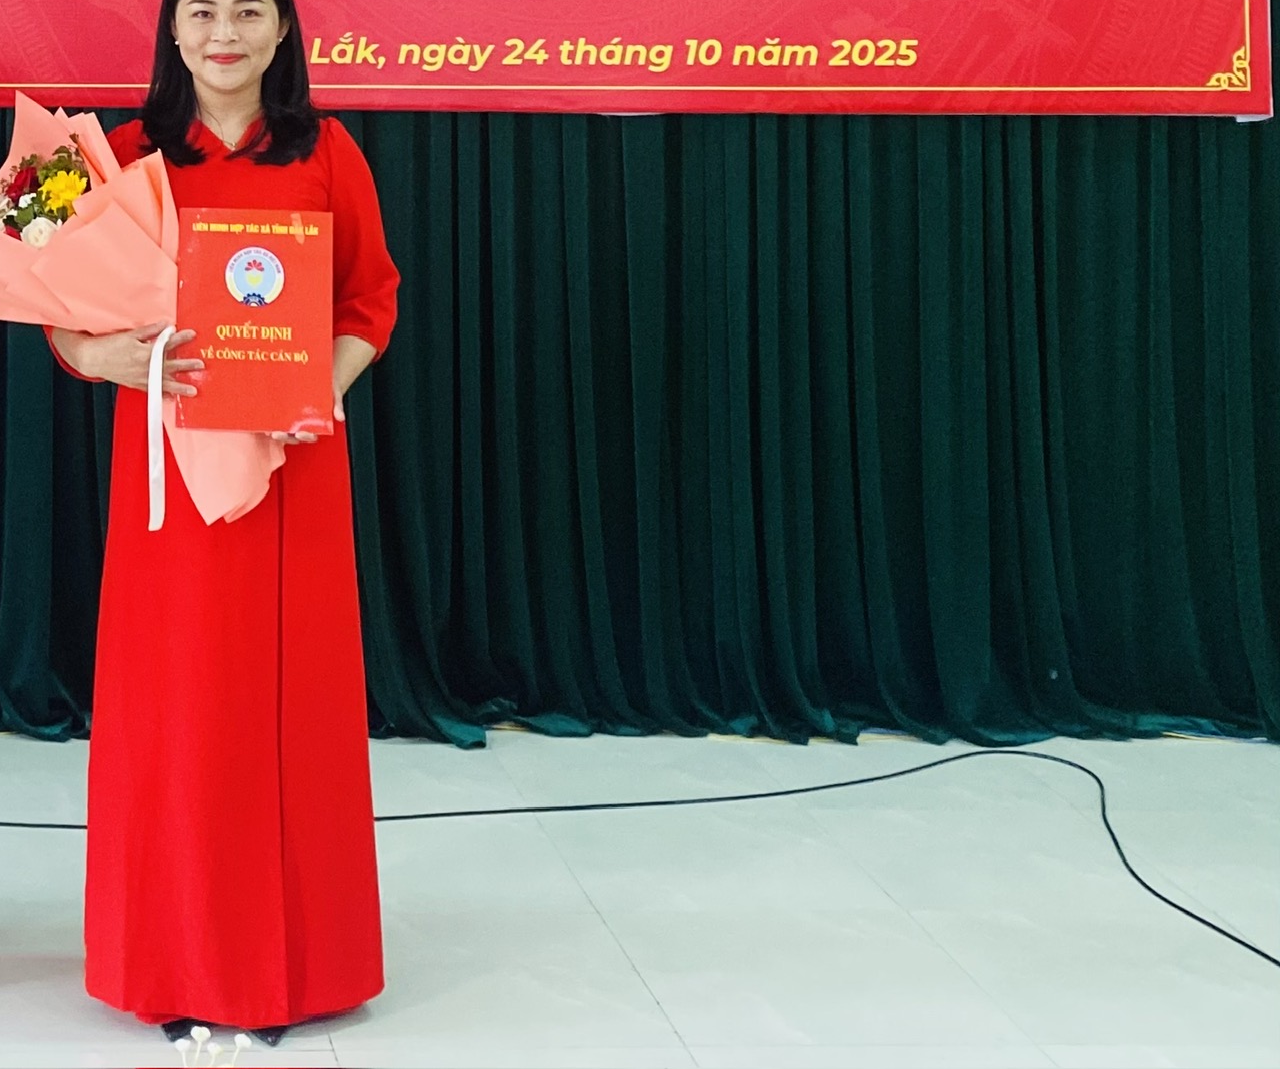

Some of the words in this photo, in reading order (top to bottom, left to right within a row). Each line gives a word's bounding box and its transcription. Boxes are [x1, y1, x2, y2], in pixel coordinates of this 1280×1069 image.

[309, 31, 387, 70] Lắk,
[397, 36, 496, 72] ngày
[501, 38, 550, 66] 24
[559, 37, 674, 73] tháng
[684, 39, 723, 66] 10
[732, 38, 819, 67] năm
[829, 39, 919, 67] 2025
[216, 320, 260, 341] QUYẾT
[261, 326, 292, 343] ĐỊNH
[216, 347, 246, 360] CÔNG
[247, 348, 270, 361] TÁC
[270, 349, 292, 362] CÁN
[293, 350, 309, 365] BỘ
